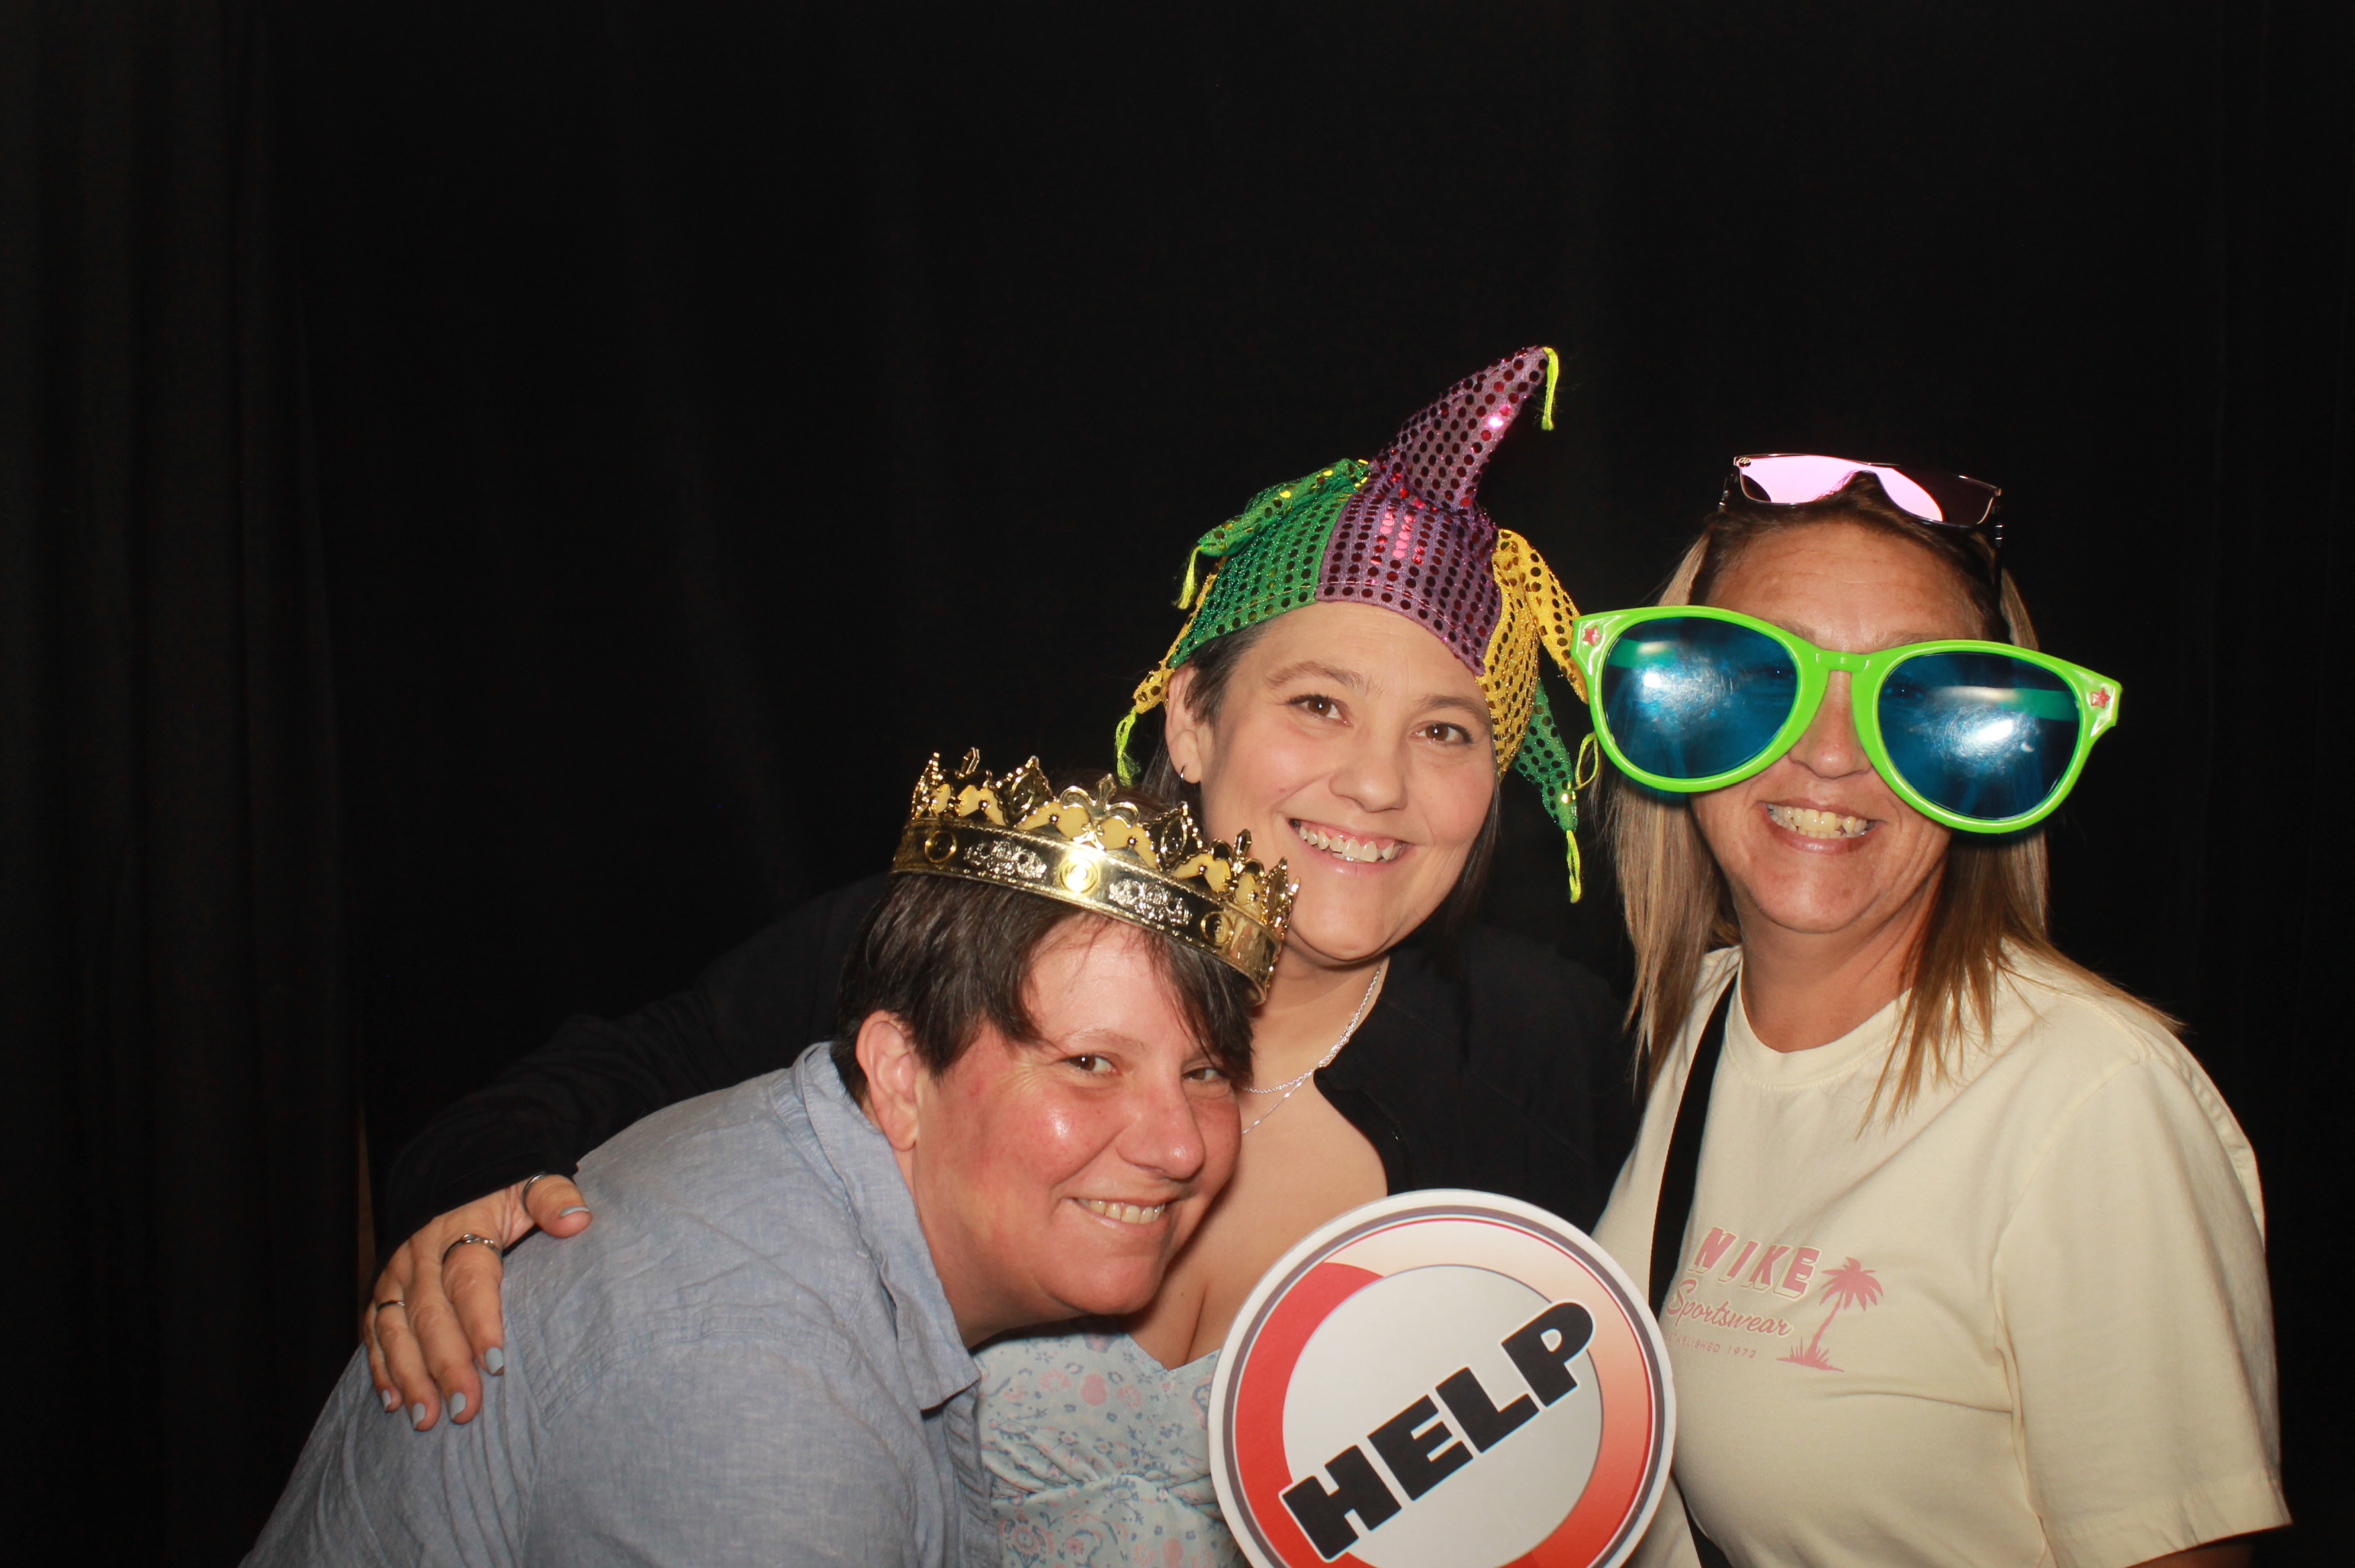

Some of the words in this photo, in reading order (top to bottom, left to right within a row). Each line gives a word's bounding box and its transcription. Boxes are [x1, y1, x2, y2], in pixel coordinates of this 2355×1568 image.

[1688, 1226, 1821, 1300] NIKE
[1666, 1278, 1794, 1336] Sportswear
[1727, 1345, 1756, 1358] 1972
[1280, 1301, 1595, 1560] HELP
